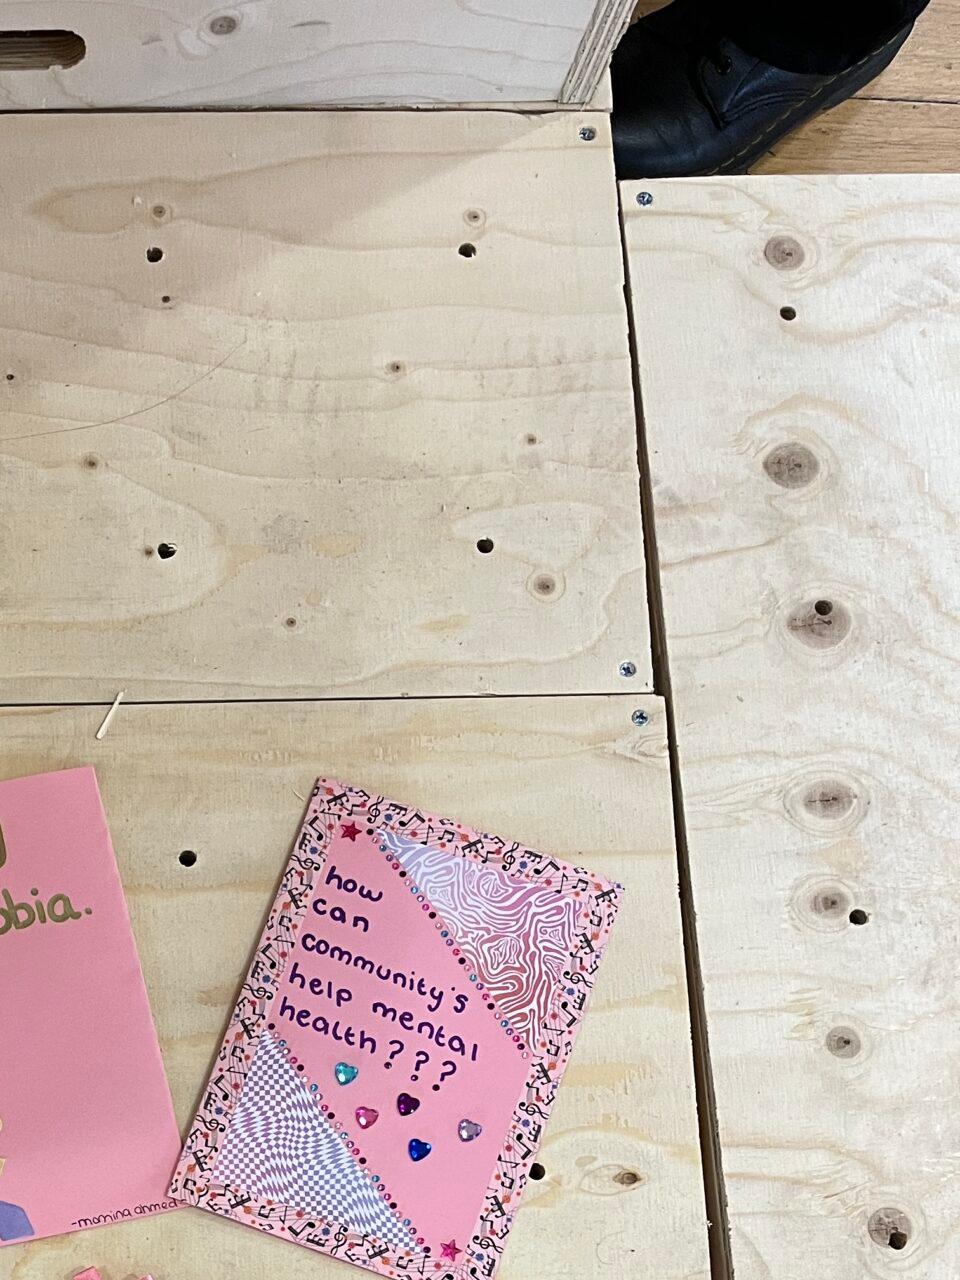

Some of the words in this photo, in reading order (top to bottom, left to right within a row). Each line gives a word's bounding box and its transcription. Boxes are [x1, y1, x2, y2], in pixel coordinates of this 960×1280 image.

[324, 865, 384, 904] how
[311, 897, 371, 933] can
[300, 931, 471, 1015] community's
[279, 996, 378, 1055] health
[288, 962, 354, 1008] help
[372, 999, 480, 1062] mental
